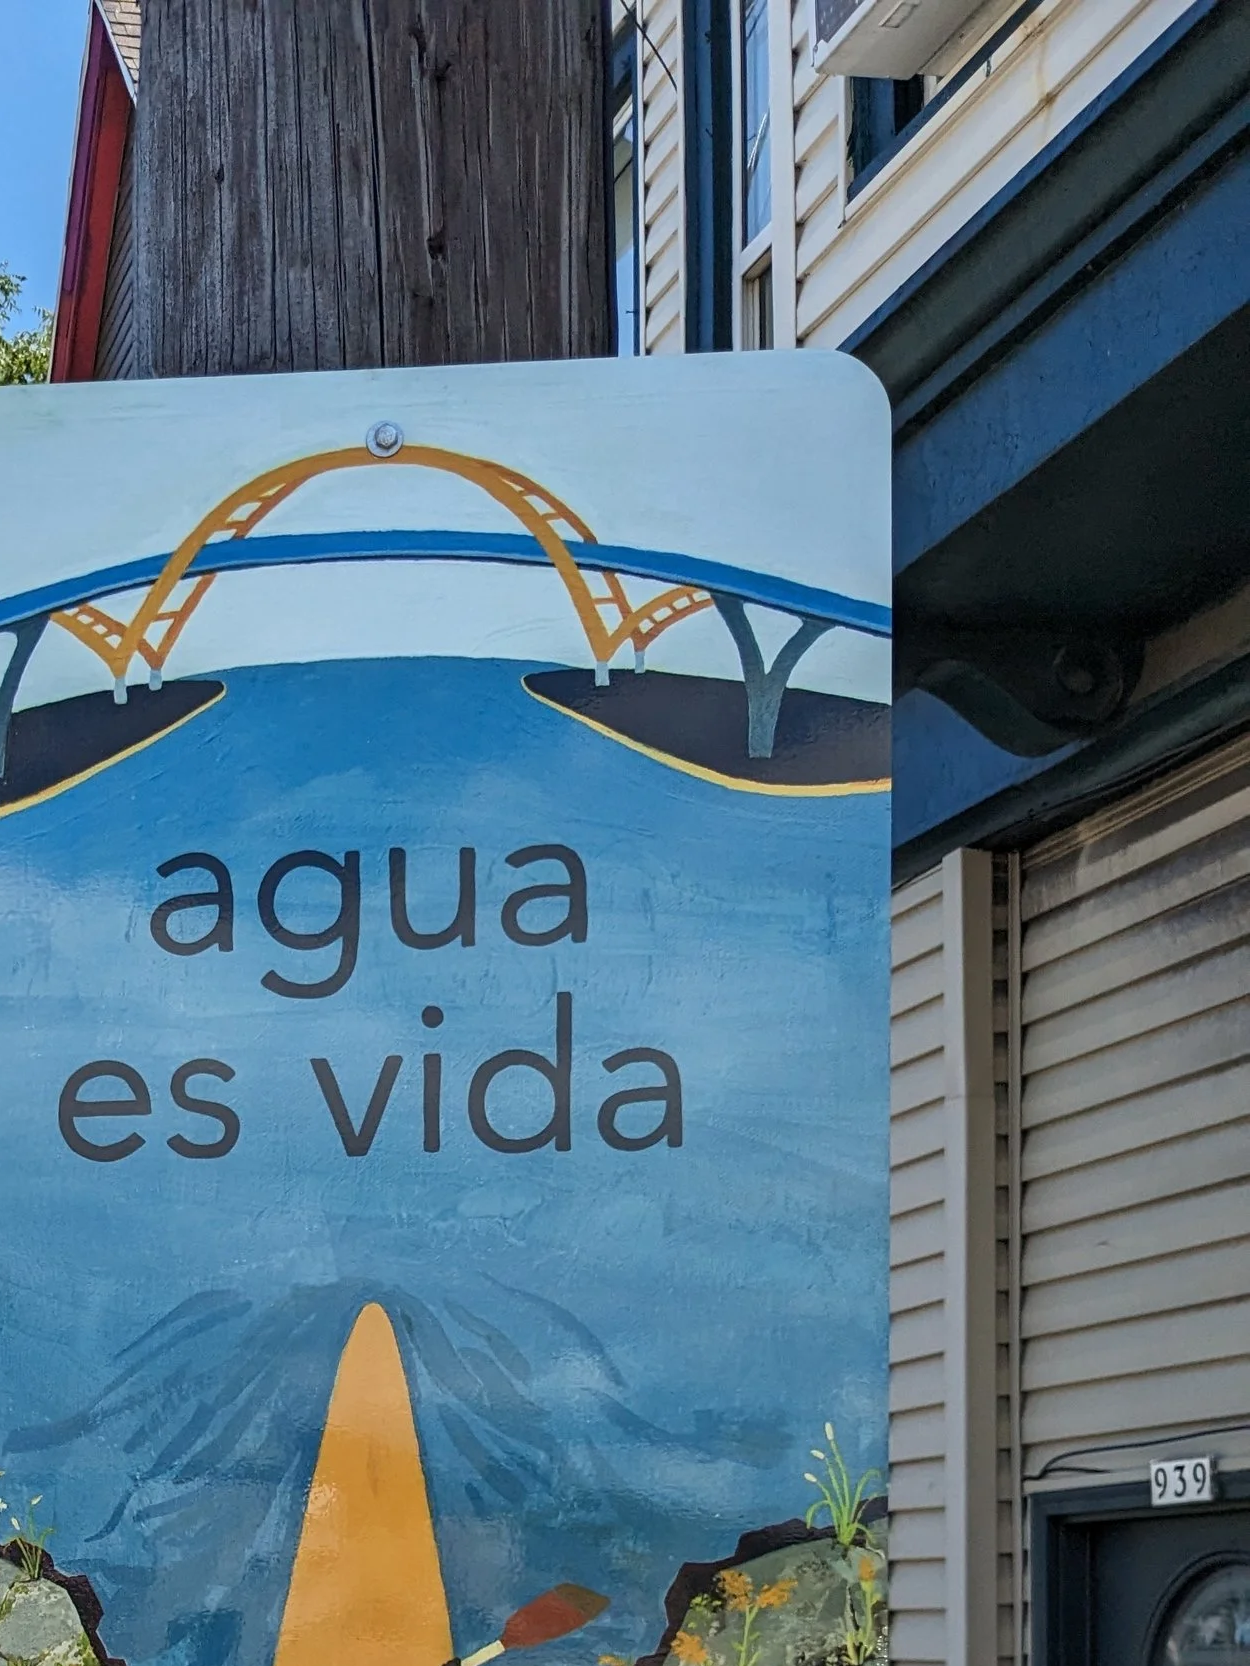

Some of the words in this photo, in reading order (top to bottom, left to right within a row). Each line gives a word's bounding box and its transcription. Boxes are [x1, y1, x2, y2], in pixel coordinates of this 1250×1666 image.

[150, 844, 588, 998] agua
[58, 1058, 240, 1162] es
[310, 991, 683, 1157] vida
[1155, 1463, 1206, 1498] 939
